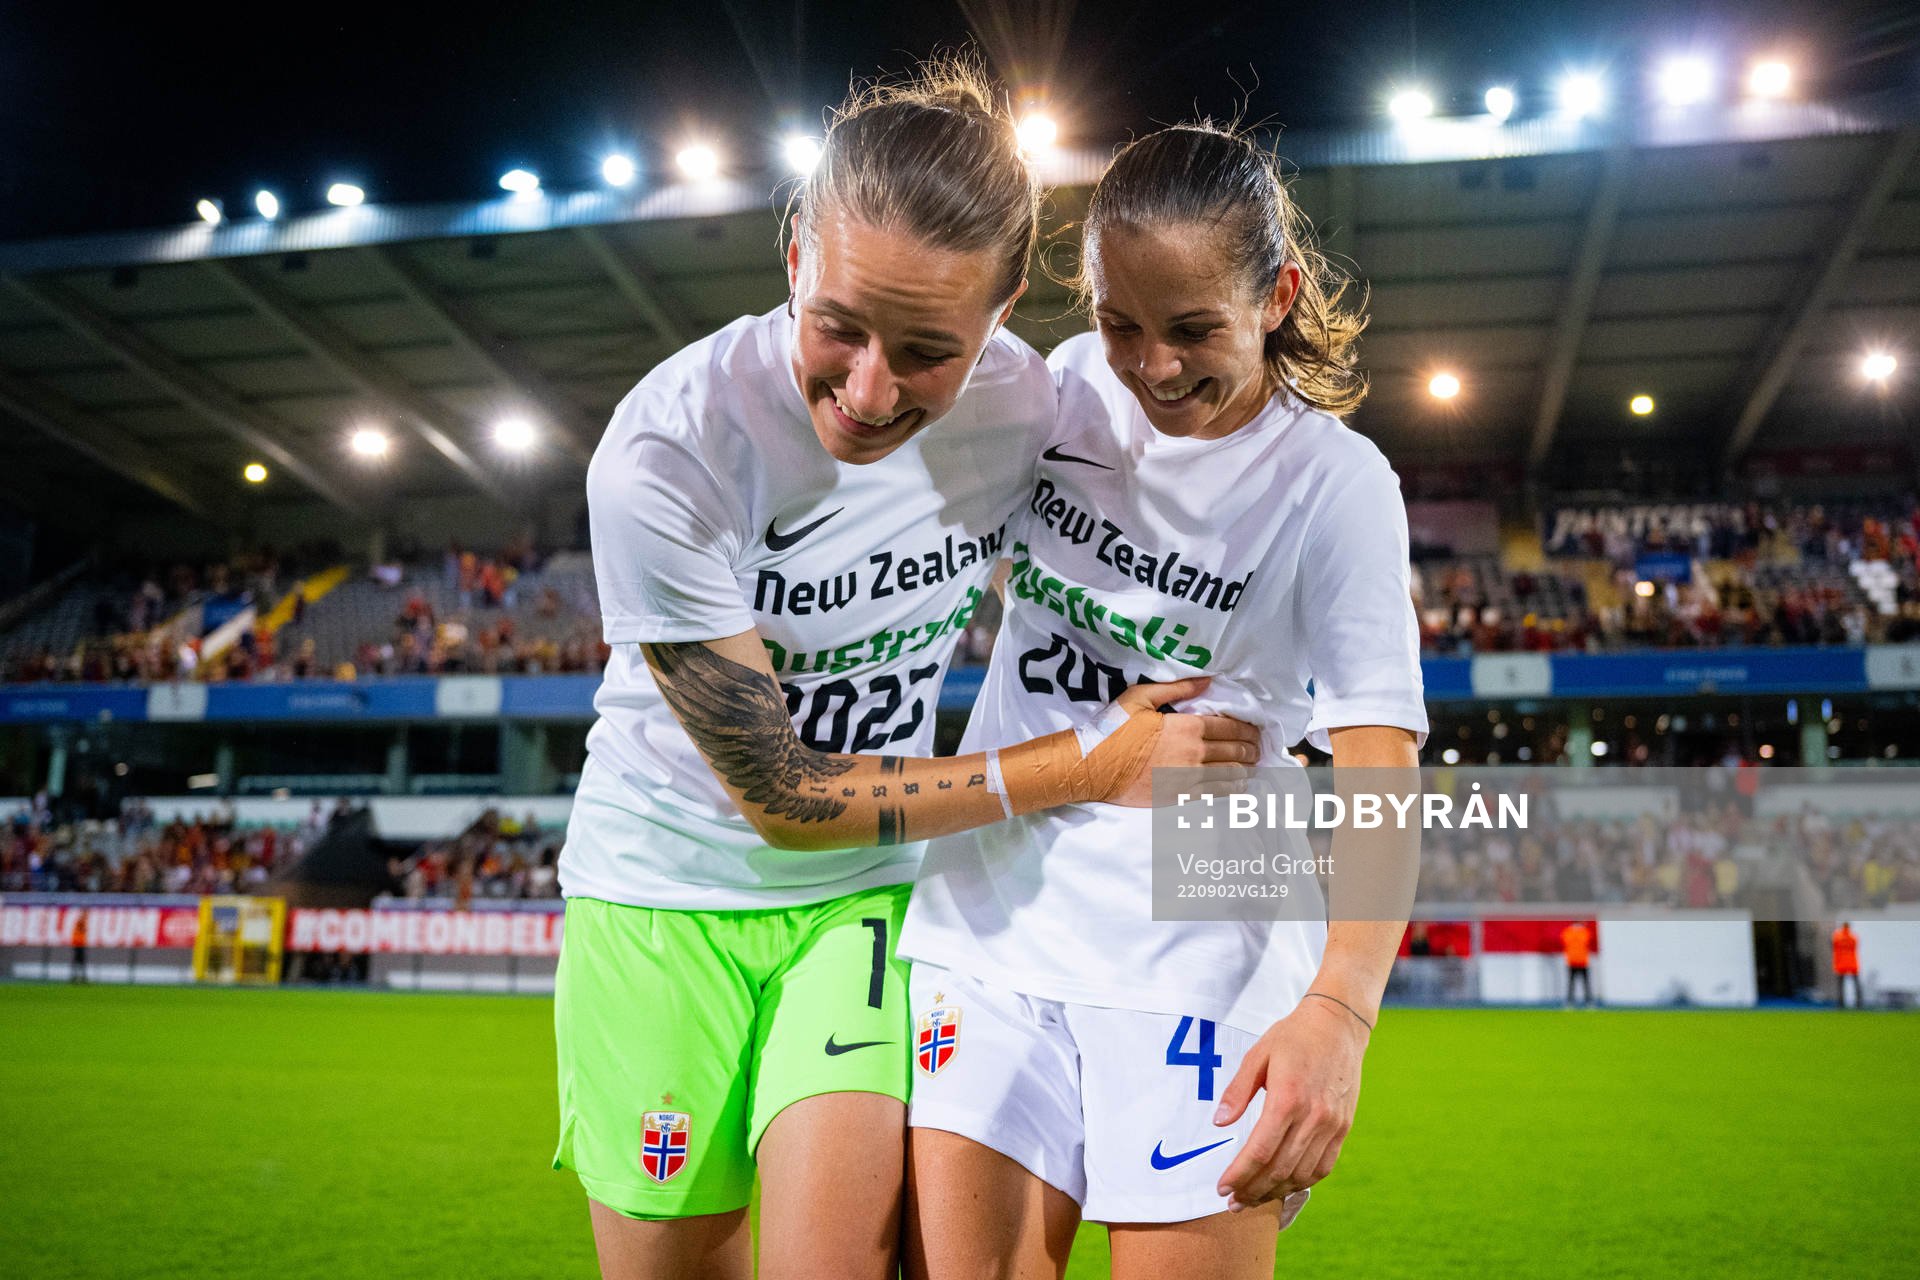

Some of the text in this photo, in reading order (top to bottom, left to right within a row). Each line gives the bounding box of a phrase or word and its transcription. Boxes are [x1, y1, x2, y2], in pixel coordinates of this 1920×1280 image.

[1031, 478, 1255, 613] New Zealand
[753, 569, 857, 616] New
[861, 917, 887, 1010] 1
[1166, 1015, 1222, 1101] 4
